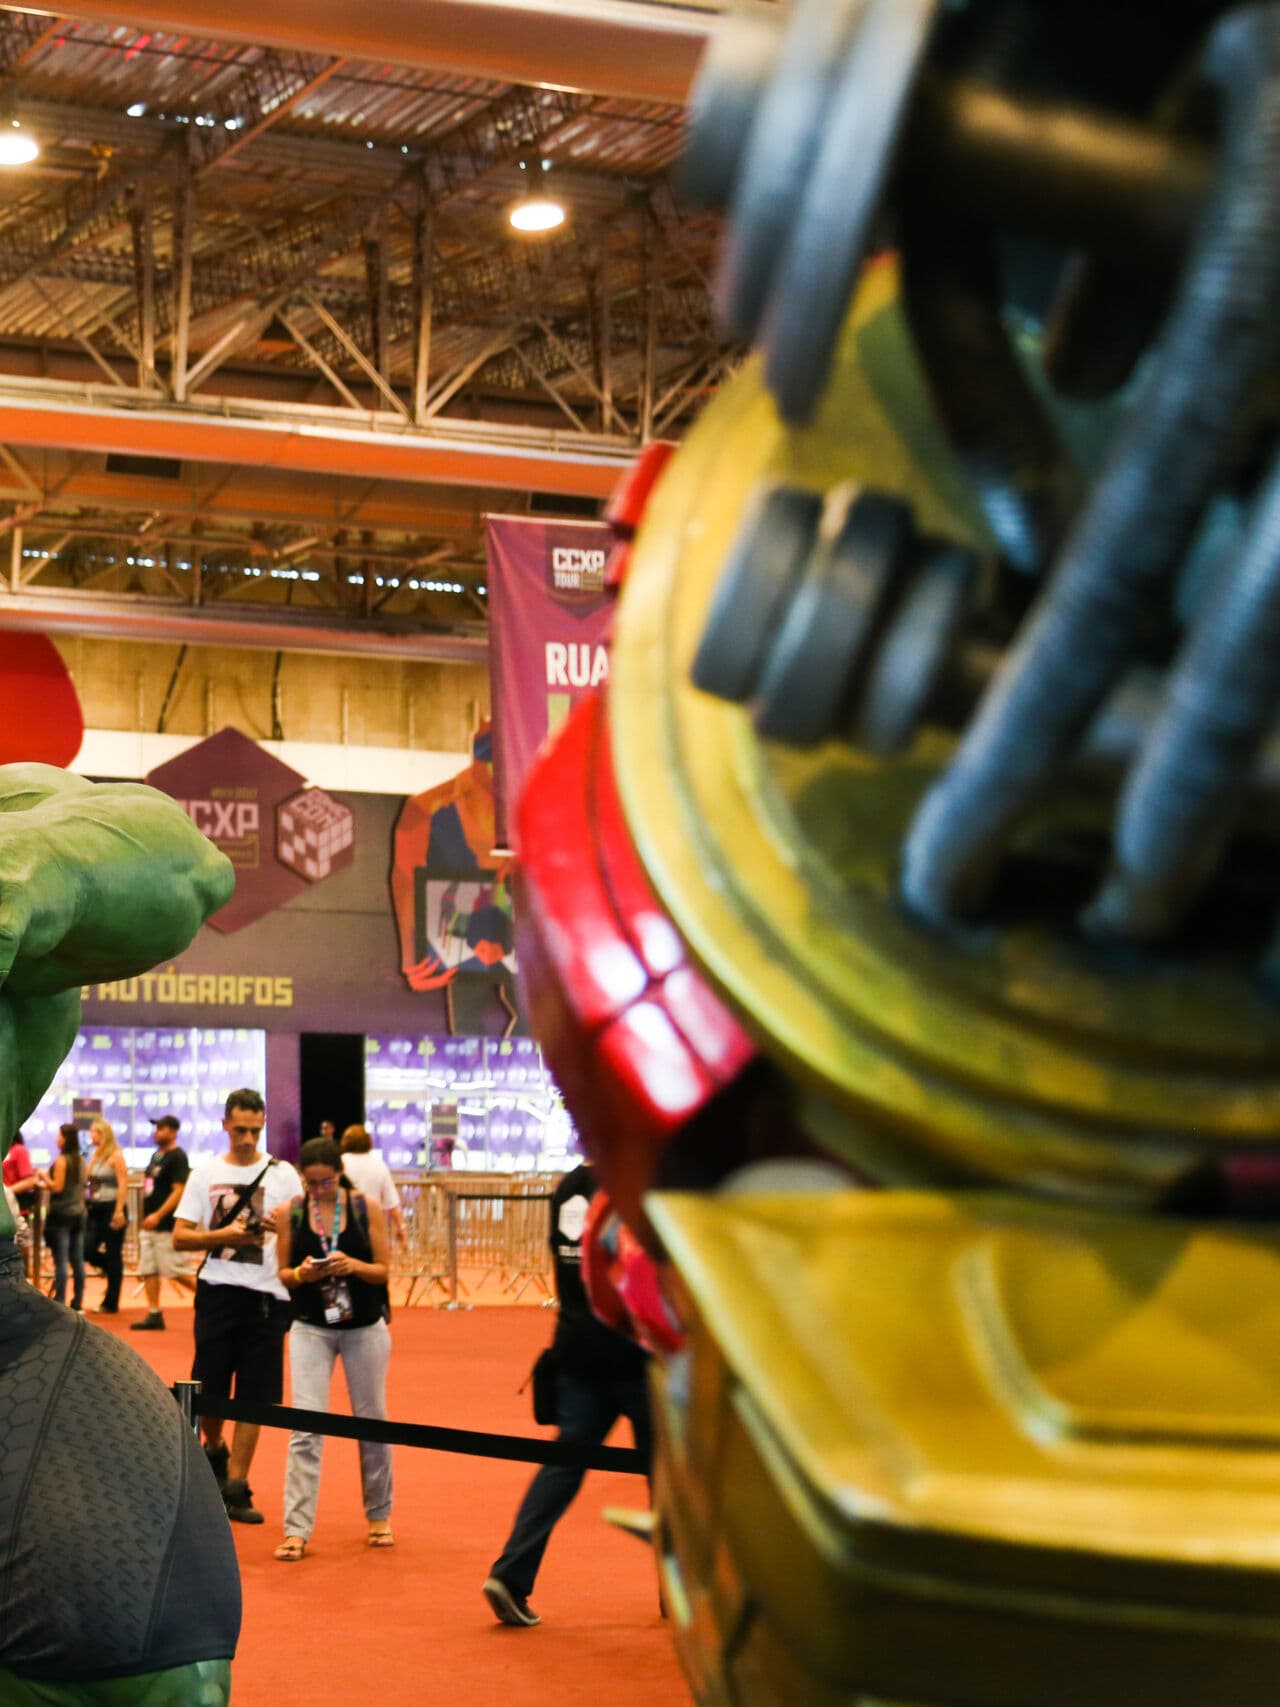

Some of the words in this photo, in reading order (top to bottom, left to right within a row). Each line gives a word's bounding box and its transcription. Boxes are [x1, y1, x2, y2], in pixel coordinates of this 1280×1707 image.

[553, 548, 605, 573] CCXP
[554, 572, 580, 588] TOUR
[545, 642, 609, 687] RUA
[177, 800, 259, 838] CXP
[99, 965, 293, 1007] AUTÓGRAFOS
